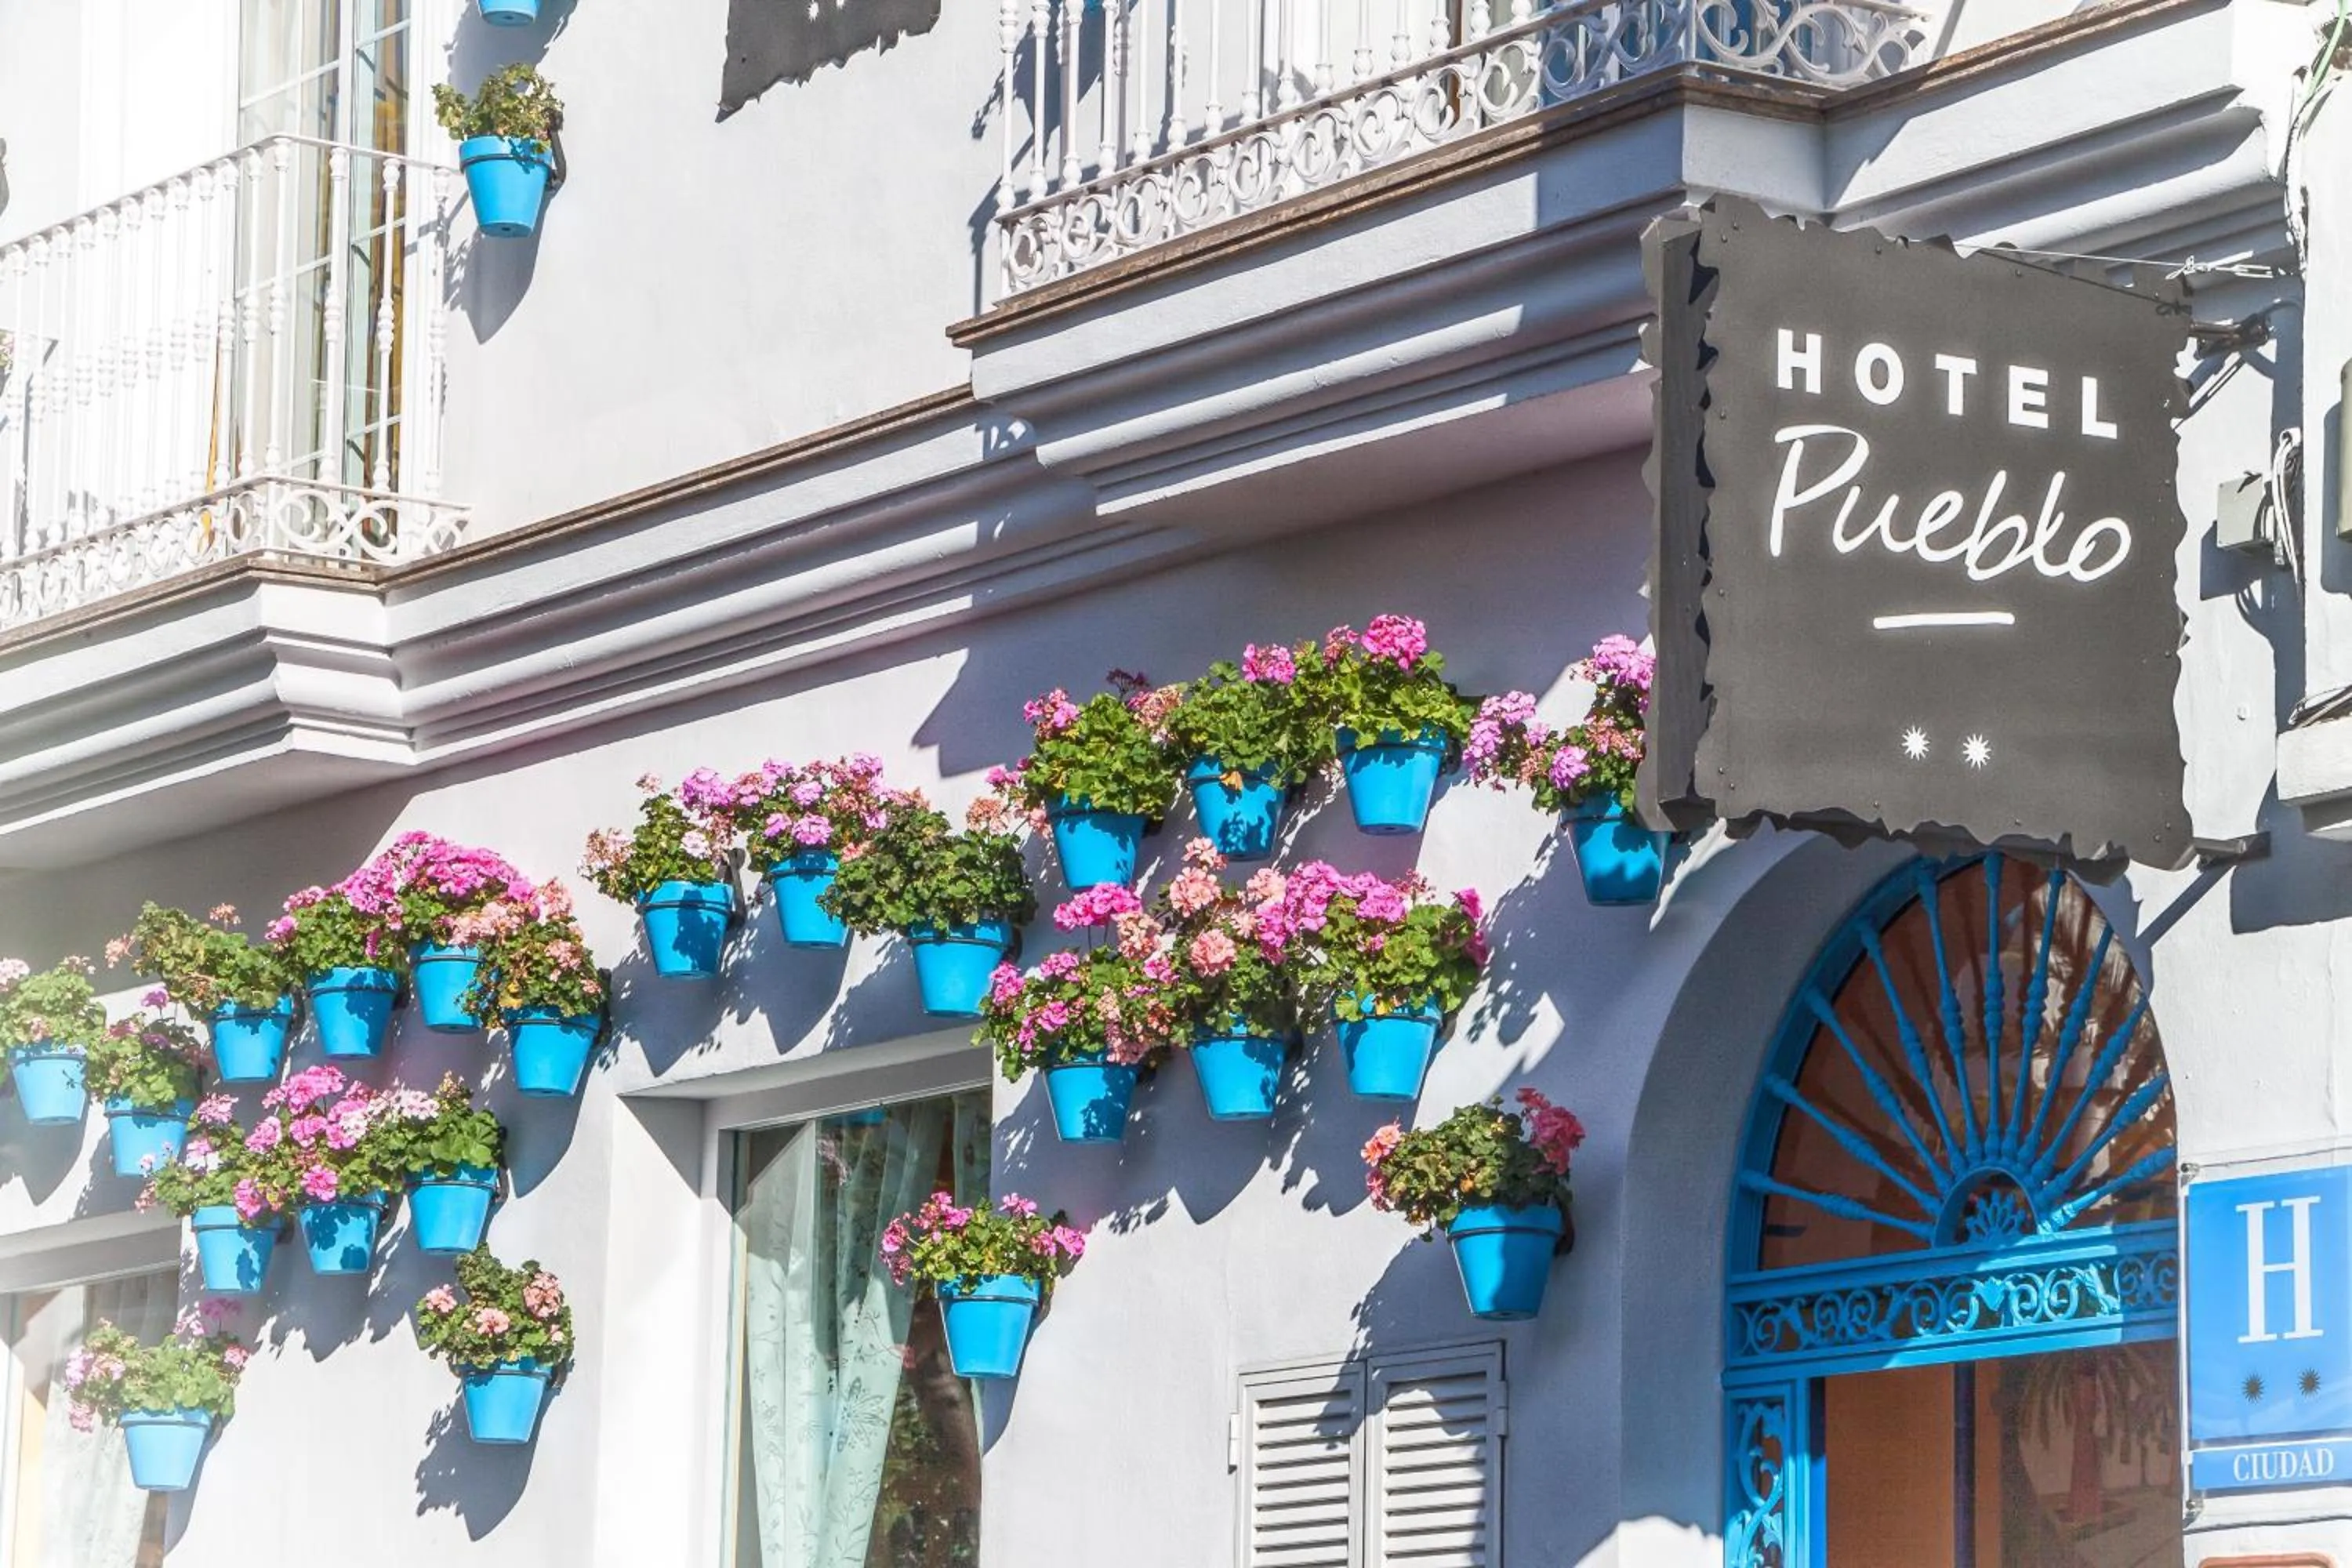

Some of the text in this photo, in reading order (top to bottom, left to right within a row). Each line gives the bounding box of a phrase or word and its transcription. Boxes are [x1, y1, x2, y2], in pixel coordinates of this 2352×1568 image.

[1777, 328, 2118, 439] HOTEL
[1769, 425, 2131, 582] Pueblo
[2235, 1196, 2323, 1343] H
[2234, 1448, 2334, 1481] CIUDAD
